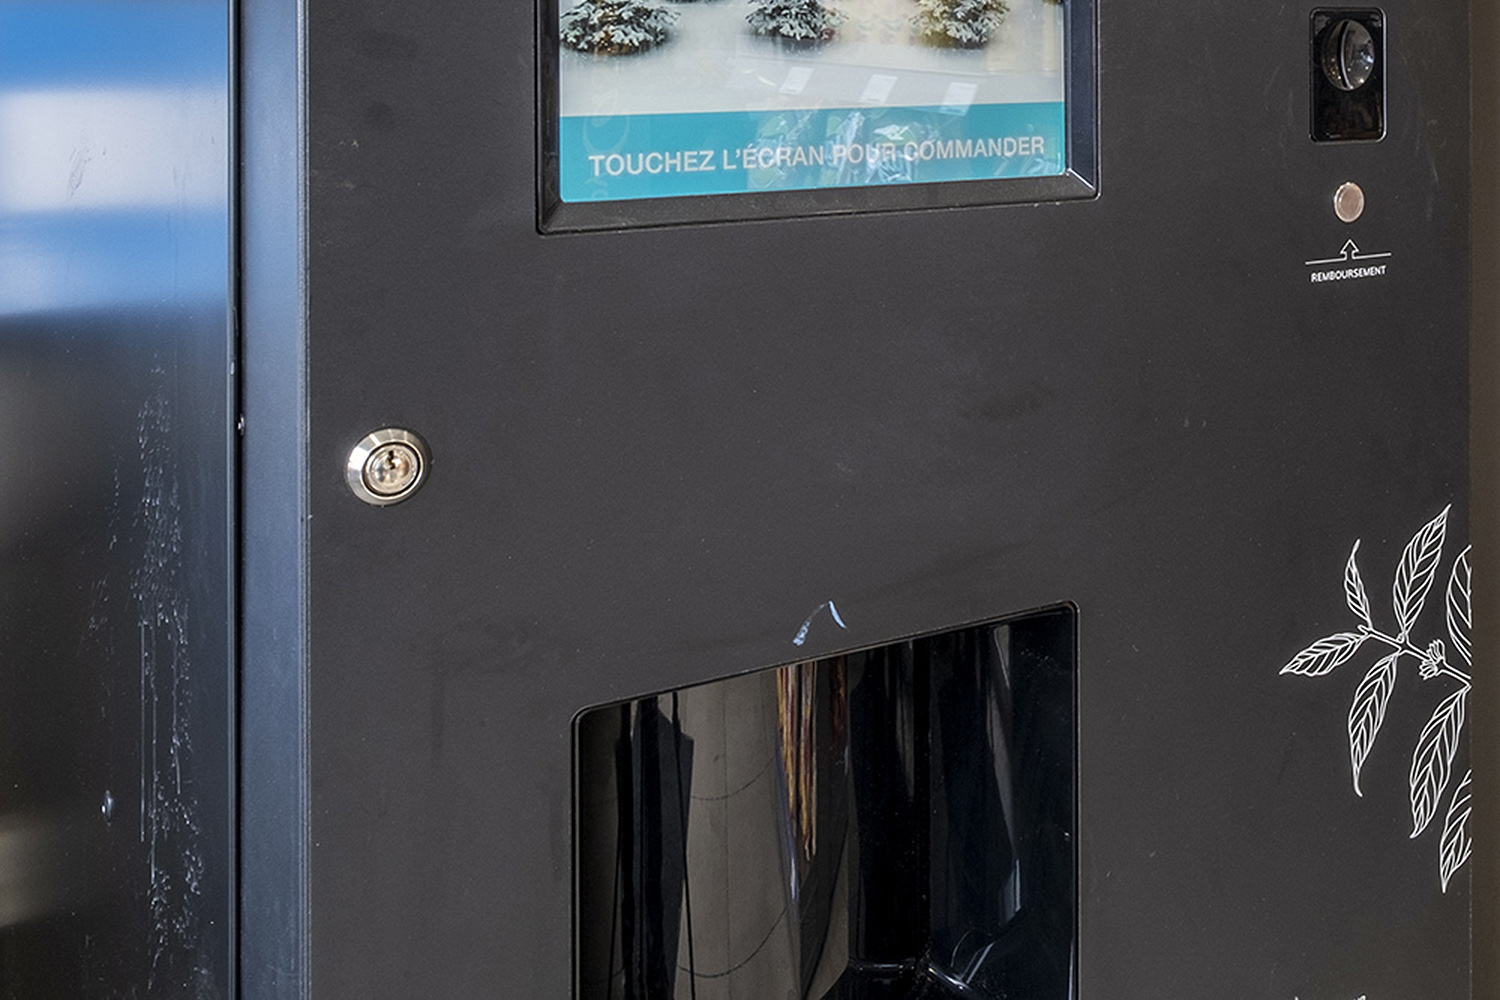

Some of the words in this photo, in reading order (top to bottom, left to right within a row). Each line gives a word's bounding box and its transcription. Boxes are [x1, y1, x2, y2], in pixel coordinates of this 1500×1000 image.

[588, 148, 716, 177] TOUCHEZ
[832, 140, 899, 164] POUR
[903, 135, 1046, 163] COMMANDER
[1311, 265, 1387, 283] REMBOURSEMENT
